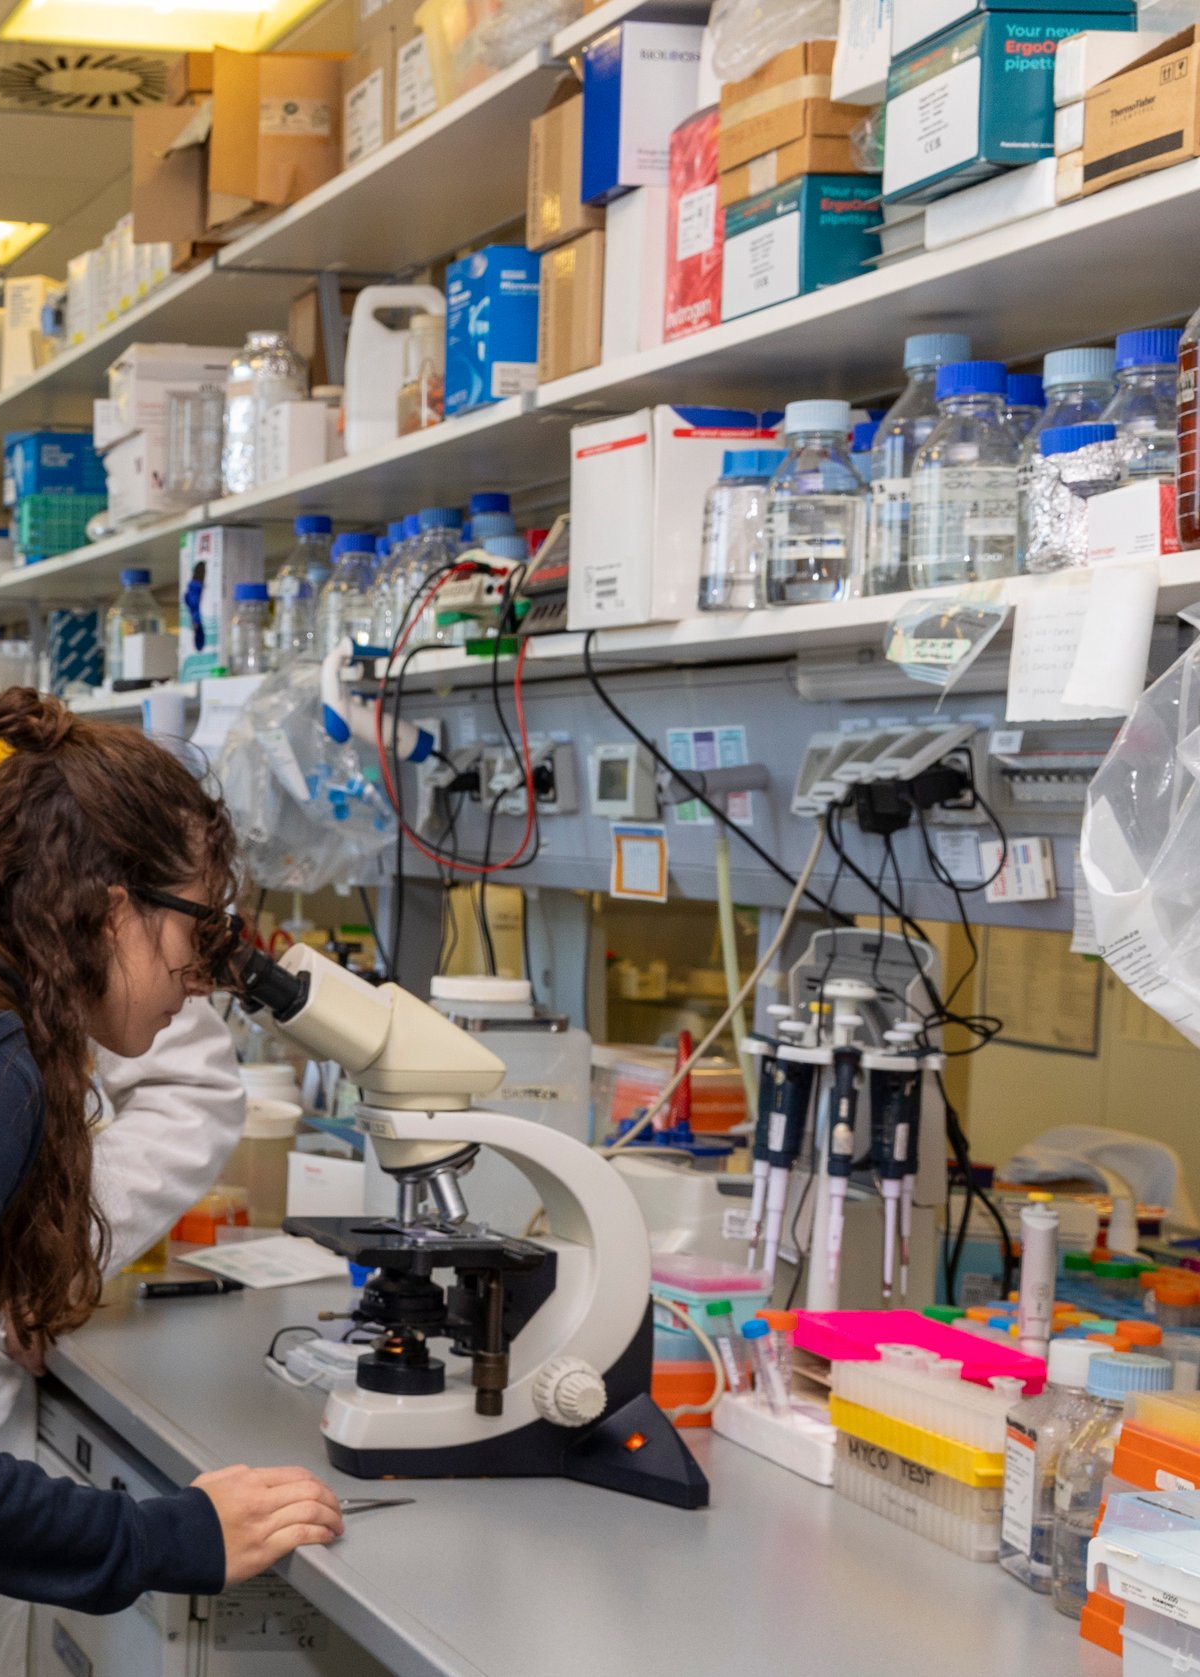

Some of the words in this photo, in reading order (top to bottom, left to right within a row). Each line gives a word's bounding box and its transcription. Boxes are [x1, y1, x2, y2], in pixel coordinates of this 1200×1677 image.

[1006, 24, 1041, 37] Your
[1046, 27, 1080, 38] new
[1005, 39, 1056, 57] ErgoO
[1004, 55, 1054, 72] pipett
[901, 1456, 934, 1487] TEST
